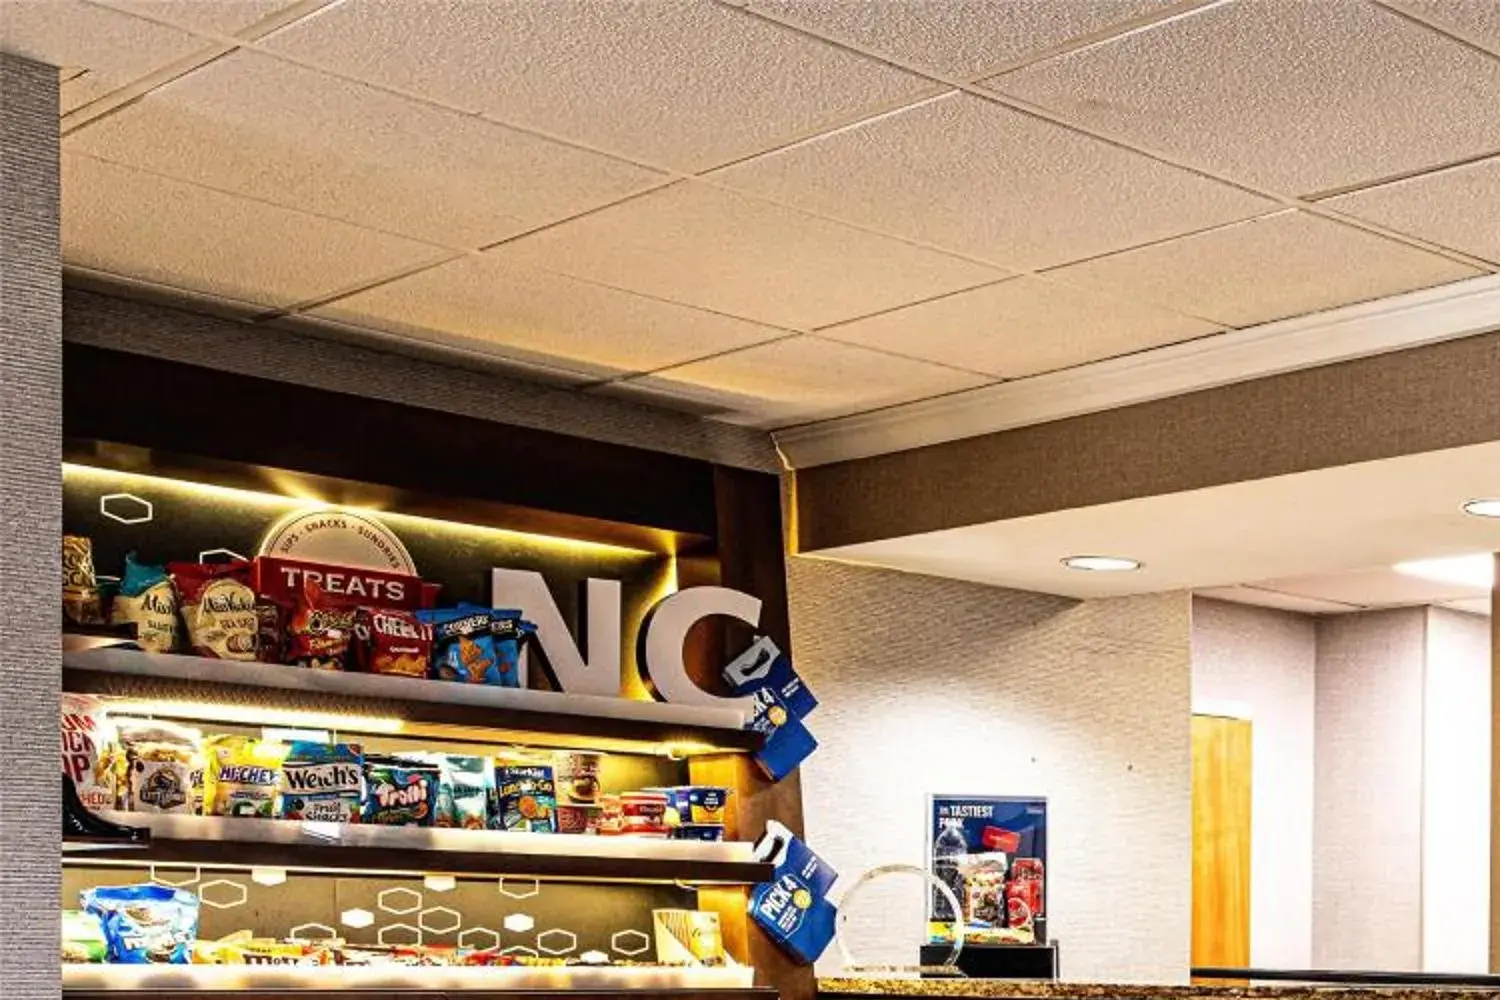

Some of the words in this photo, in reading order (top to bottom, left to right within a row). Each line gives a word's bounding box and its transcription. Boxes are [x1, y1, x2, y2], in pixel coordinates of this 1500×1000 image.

[305, 518, 347, 533] SNACKS
[357, 526, 400, 569] SUNDRIES
[280, 566, 405, 601] TREATS
[282, 765, 359, 789] Welch's
[950, 804, 995, 819] TASTIEST
[760, 880, 793, 921] PICK
